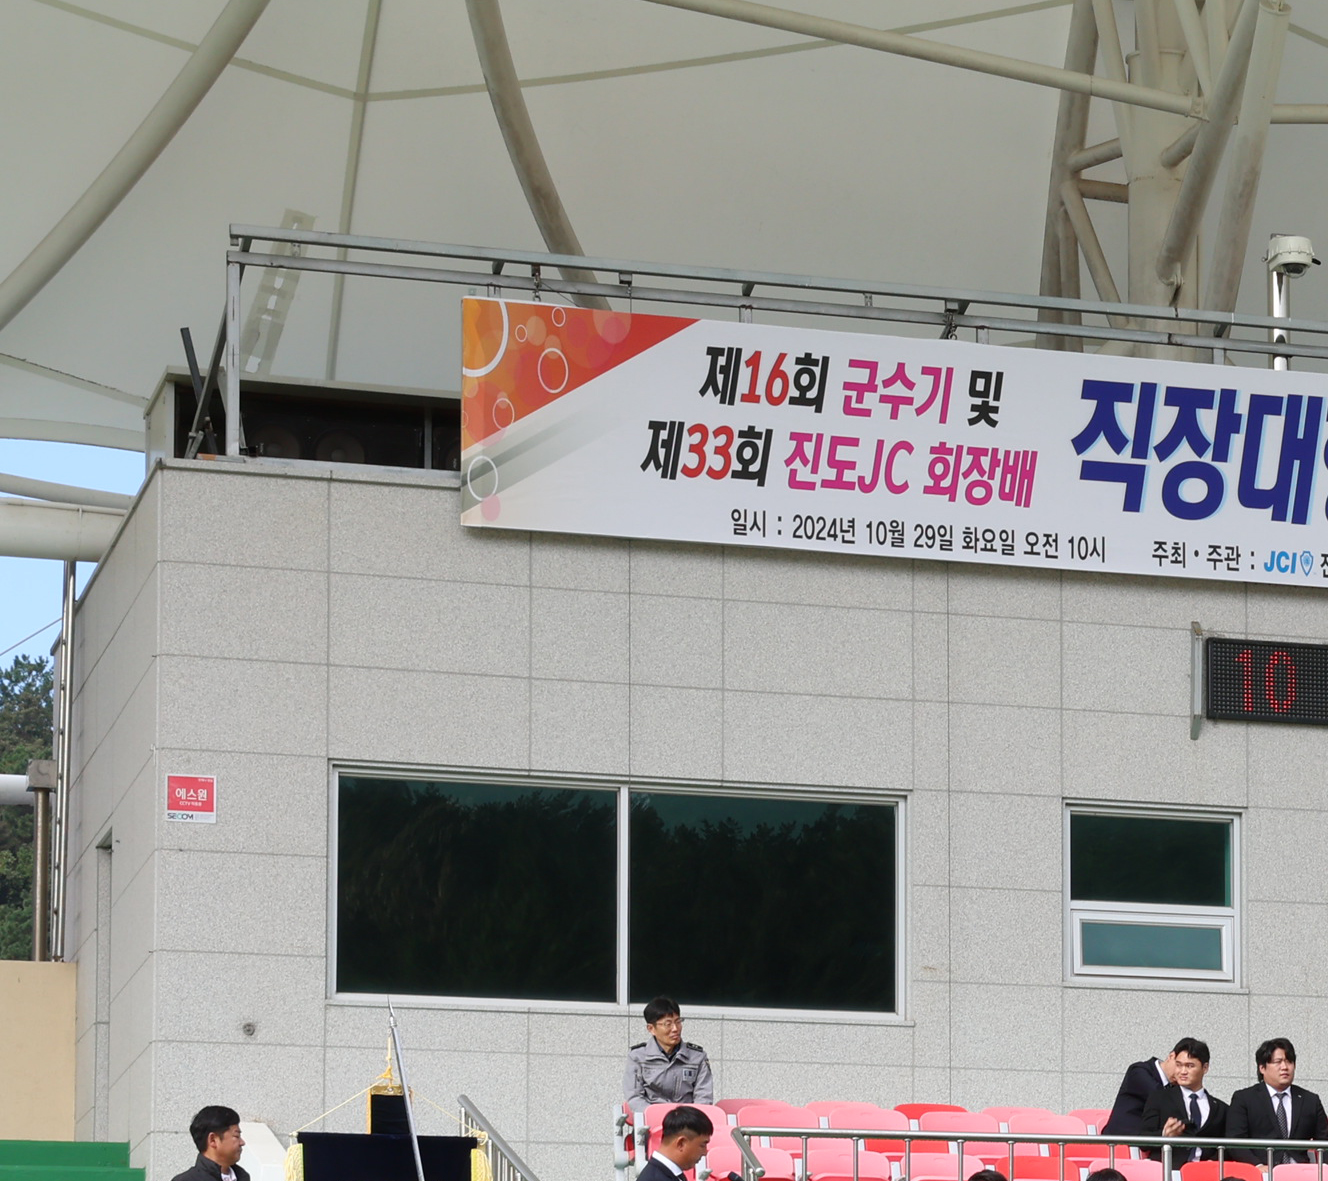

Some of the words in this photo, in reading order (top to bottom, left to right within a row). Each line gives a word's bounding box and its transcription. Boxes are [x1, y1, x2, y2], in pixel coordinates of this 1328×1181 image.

[699, 346, 829, 413] 제16회
[842, 358, 954, 424] 군수기
[967, 370, 1004, 428] 및
[640, 420, 773, 487] 제33회
[784, 431, 914, 496] 진도JC
[923, 441, 1038, 509] 회장배
[731, 509, 767, 537] 일시
[792, 514, 856, 544] 2024년
[866, 519, 905, 548] 10월
[914, 523, 954, 552] 29일
[962, 525, 1015, 556] 화요일
[1023, 531, 1059, 559] 오전
[1068, 535, 1106, 563] 10시
[1152, 541, 1186, 568] 주최
[1206, 544, 1241, 571] 주관
[1263, 550, 1297, 574] JCI
[1236, 650, 1296, 712] 10
[175, 788, 207, 801] 에스원
